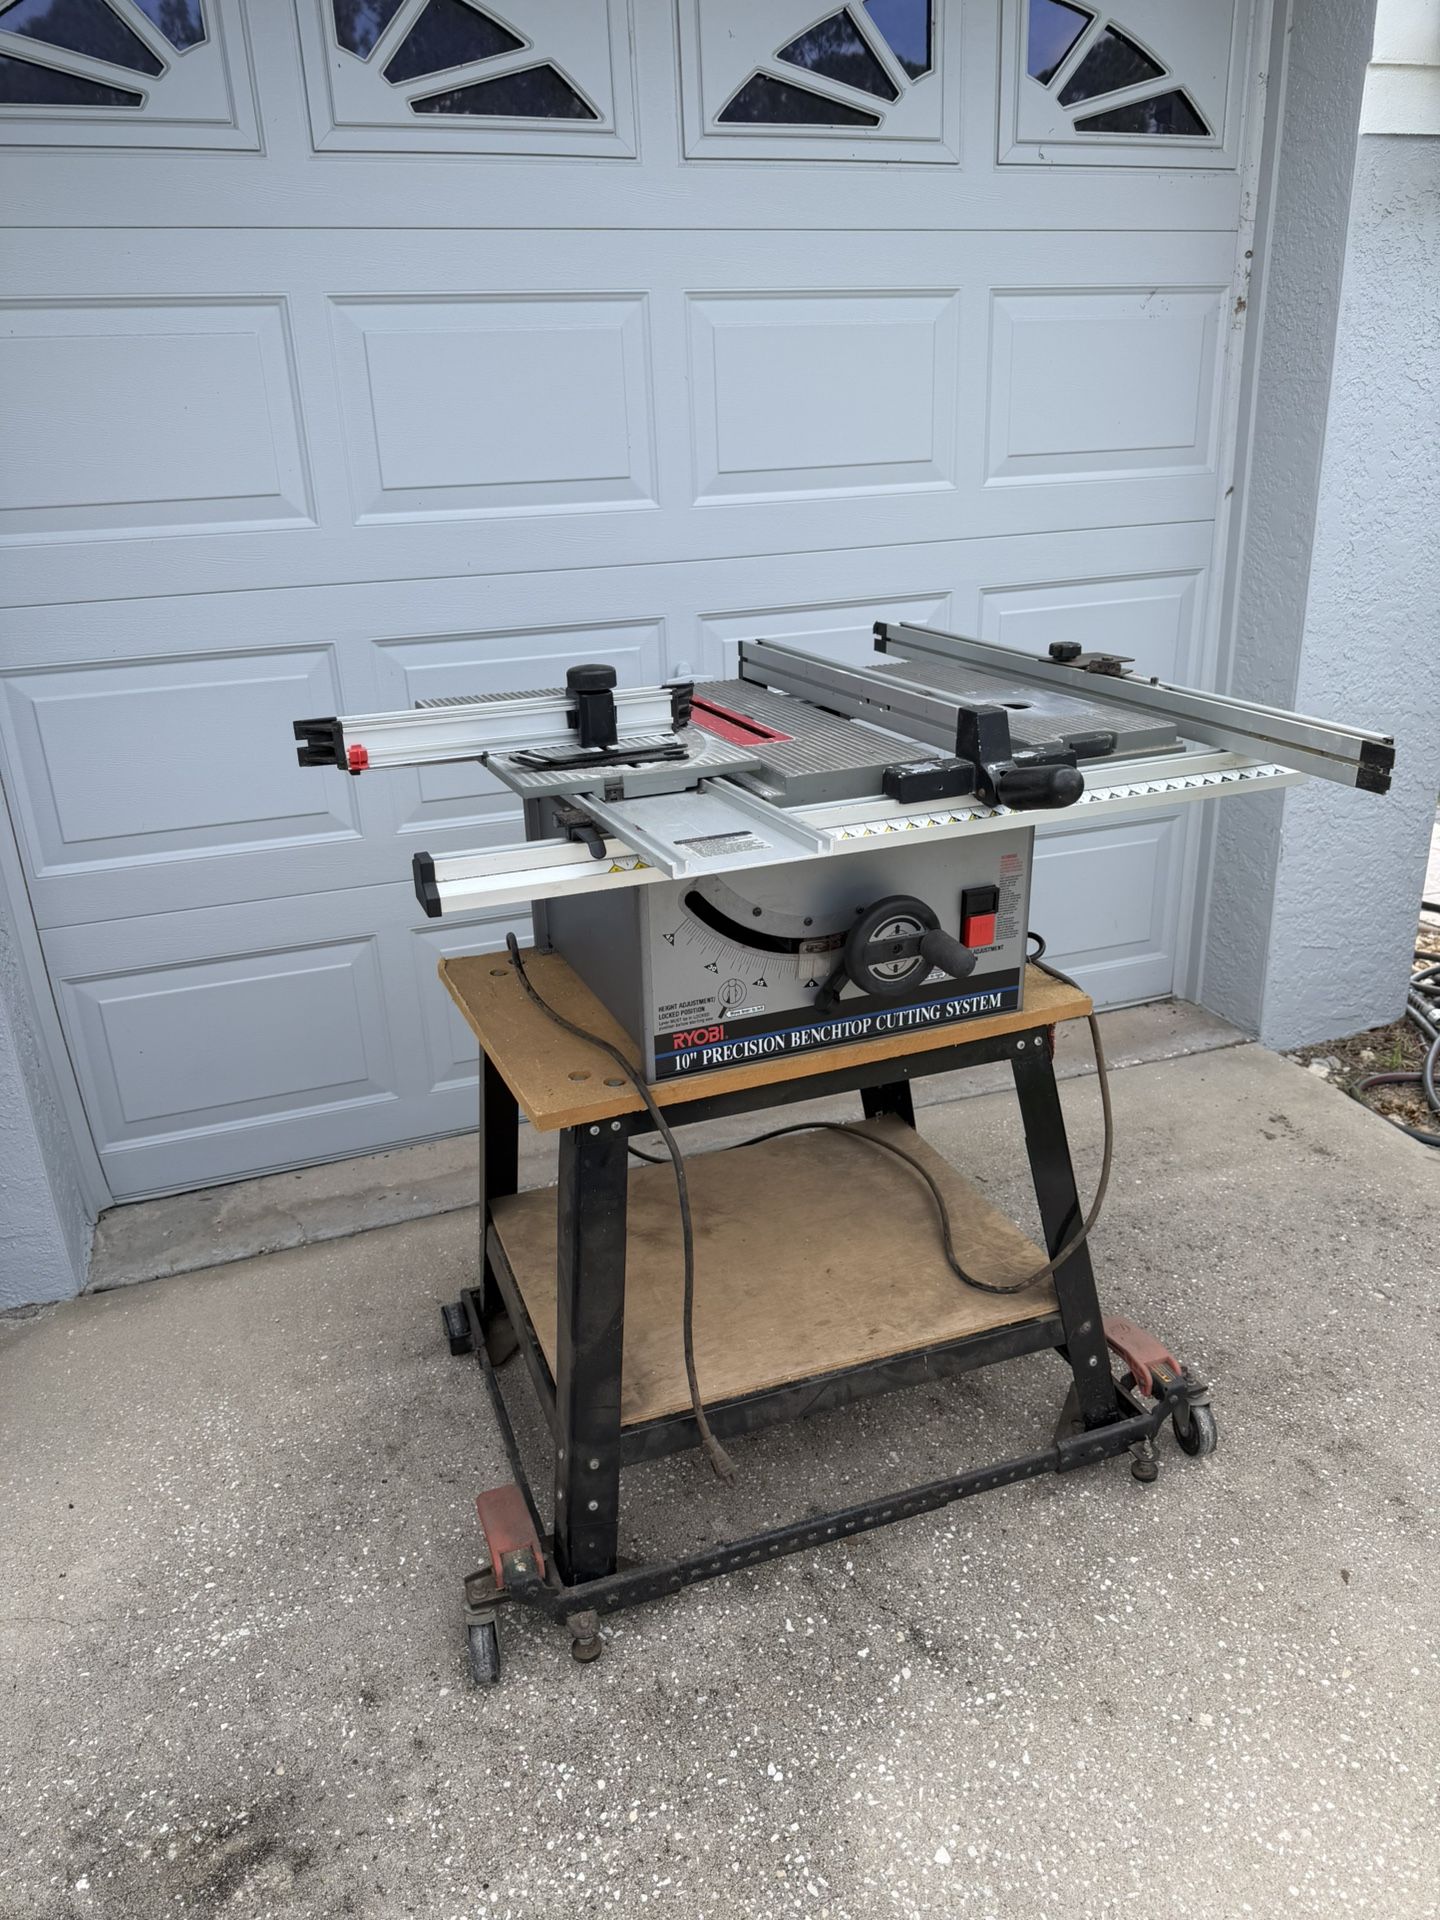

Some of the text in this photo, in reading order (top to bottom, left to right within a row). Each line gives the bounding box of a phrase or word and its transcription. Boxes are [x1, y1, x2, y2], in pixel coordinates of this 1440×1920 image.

[658, 1003, 678, 1013] HEIGHT
[658, 1006, 705, 1021] LOCKED POSITION
[672, 1024, 725, 1050] RYOBI
[675, 992, 1002, 1071] 10" PRECISION BENCHTOP CUTTING SYSTEM
